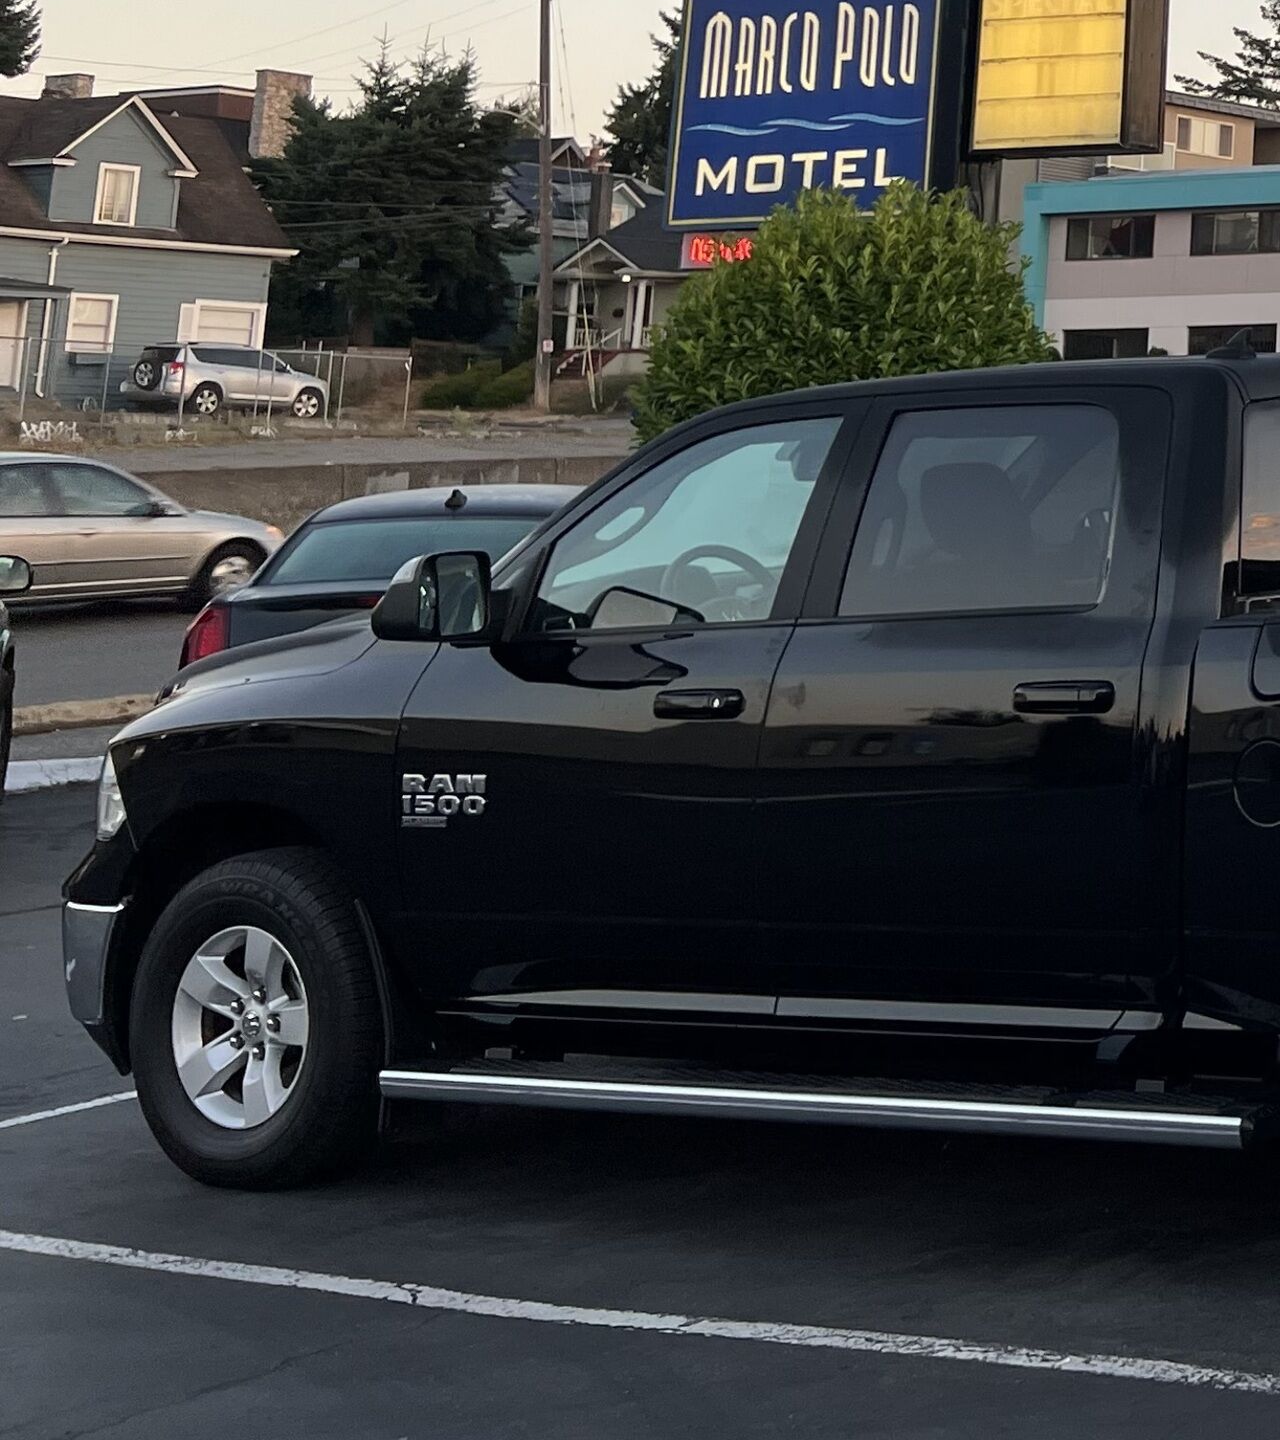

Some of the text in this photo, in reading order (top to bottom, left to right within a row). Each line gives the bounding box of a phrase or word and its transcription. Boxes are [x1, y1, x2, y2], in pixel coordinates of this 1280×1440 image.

[699, 1, 920, 99] MARCO POLO
[694, 147, 905, 197] MOTEL
[402, 773, 487, 794] RAM
[401, 794, 487, 815] 1500
